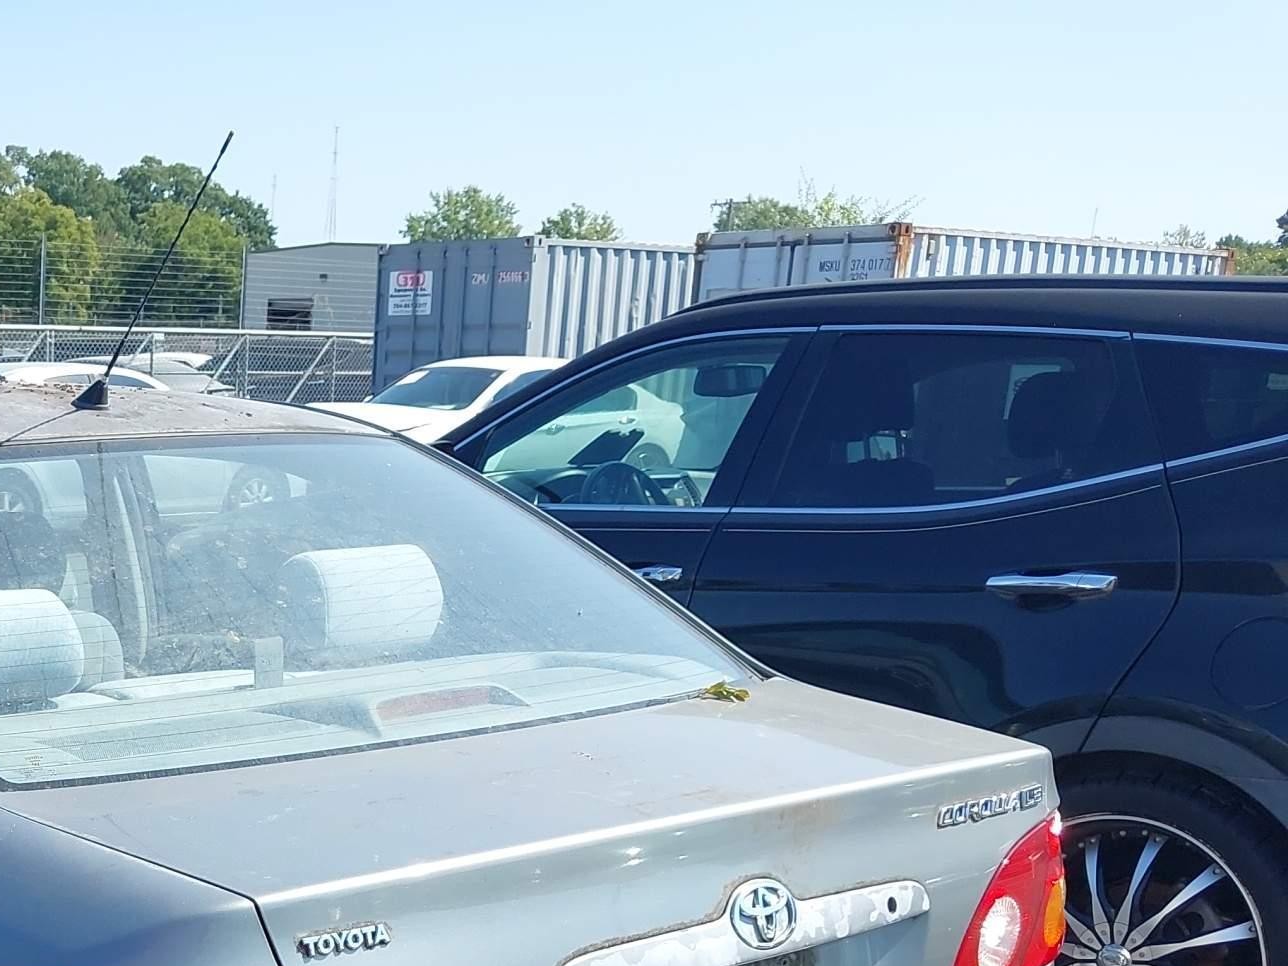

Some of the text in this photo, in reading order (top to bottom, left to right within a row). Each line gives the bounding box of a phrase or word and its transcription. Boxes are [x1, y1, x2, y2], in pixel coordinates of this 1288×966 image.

[819, 259, 841, 273] MSKU
[850, 259, 866, 272] 374
[937, 791, 1020, 829] COROLLA
[298, 923, 392, 959] TOYOTA
